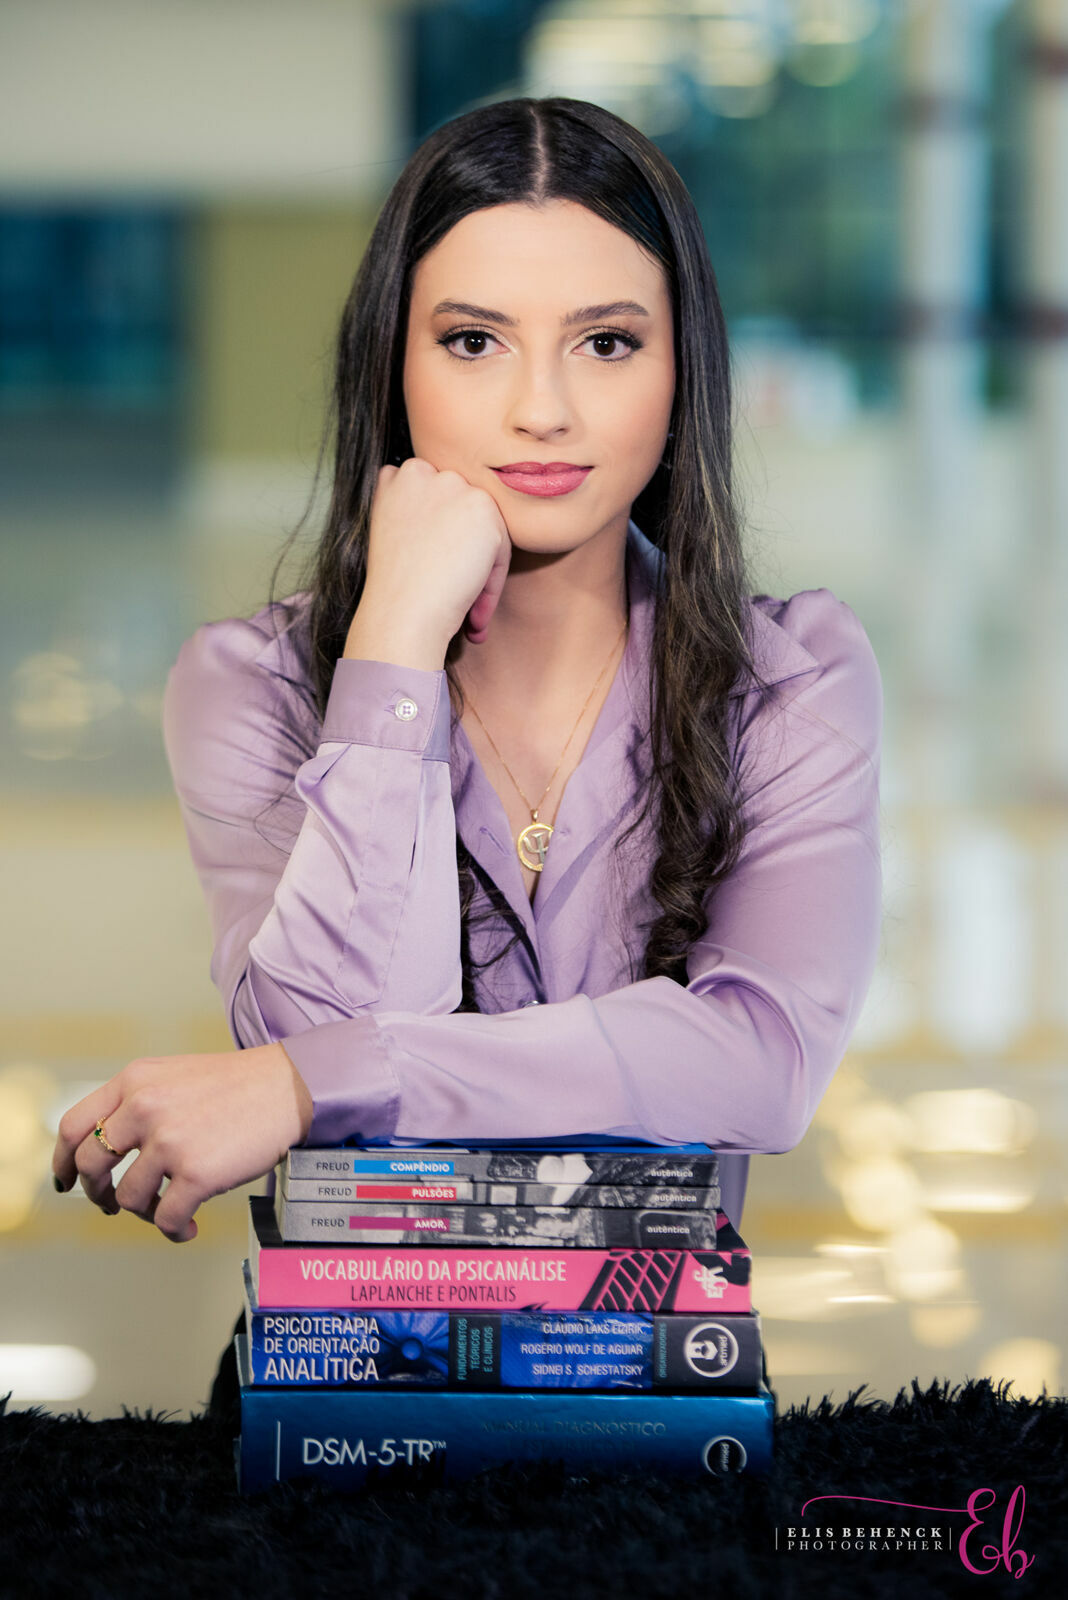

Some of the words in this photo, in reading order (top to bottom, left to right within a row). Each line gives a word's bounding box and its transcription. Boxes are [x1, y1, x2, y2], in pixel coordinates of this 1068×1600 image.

[316, 1161, 350, 1171] FREUD
[390, 1160, 450, 1172] COMPÊNDIO
[318, 1187, 352, 1196] FREUD
[412, 1187, 455, 1198] PULSÕES
[311, 1218, 345, 1227] FREUD
[414, 1219, 447, 1230] AMOR,
[301, 1256, 424, 1281] VOCABULÁRIO
[428, 1260, 451, 1281] DA
[456, 1257, 567, 1282] PSICANÁLISE
[351, 1285, 433, 1302] LAPLANCHE
[438, 1286, 445, 1302] E
[450, 1286, 516, 1303] PONTALIS
[264, 1316, 380, 1335] PSICOTERAPIA
[585, 1322, 610, 1334] LAKS
[612, 1323, 643, 1334] EIZIRIK
[264, 1337, 284, 1354] DE
[287, 1335, 380, 1357] ORIENTAÇÃO
[457, 1318, 468, 1381] FUNDAMENTOS
[564, 1343, 591, 1355] WOLF
[593, 1343, 606, 1355] DE
[607, 1344, 644, 1356] AGUIAR
[264, 1353, 380, 1381] ANALÍTICA
[532, 1364, 563, 1376] SIDNEI
[577, 1364, 644, 1376] SCHESTATSKY
